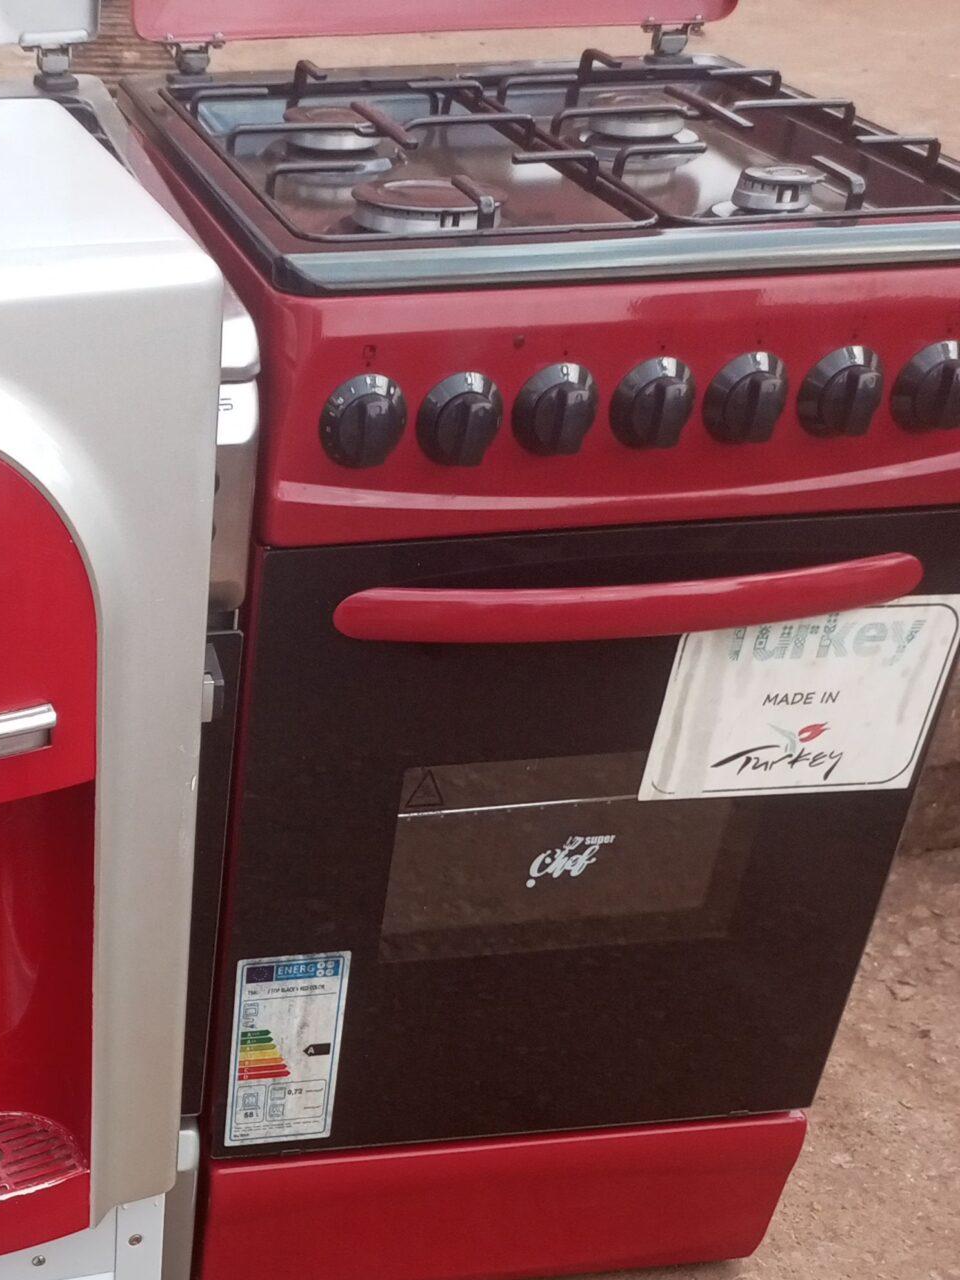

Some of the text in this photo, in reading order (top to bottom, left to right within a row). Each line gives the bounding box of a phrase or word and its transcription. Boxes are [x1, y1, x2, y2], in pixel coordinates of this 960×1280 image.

[762, 690, 841, 706] MADE IN
[584, 834, 616, 846] super
[277, 963, 316, 975] ENERG
[307, 1046, 315, 1054] A
